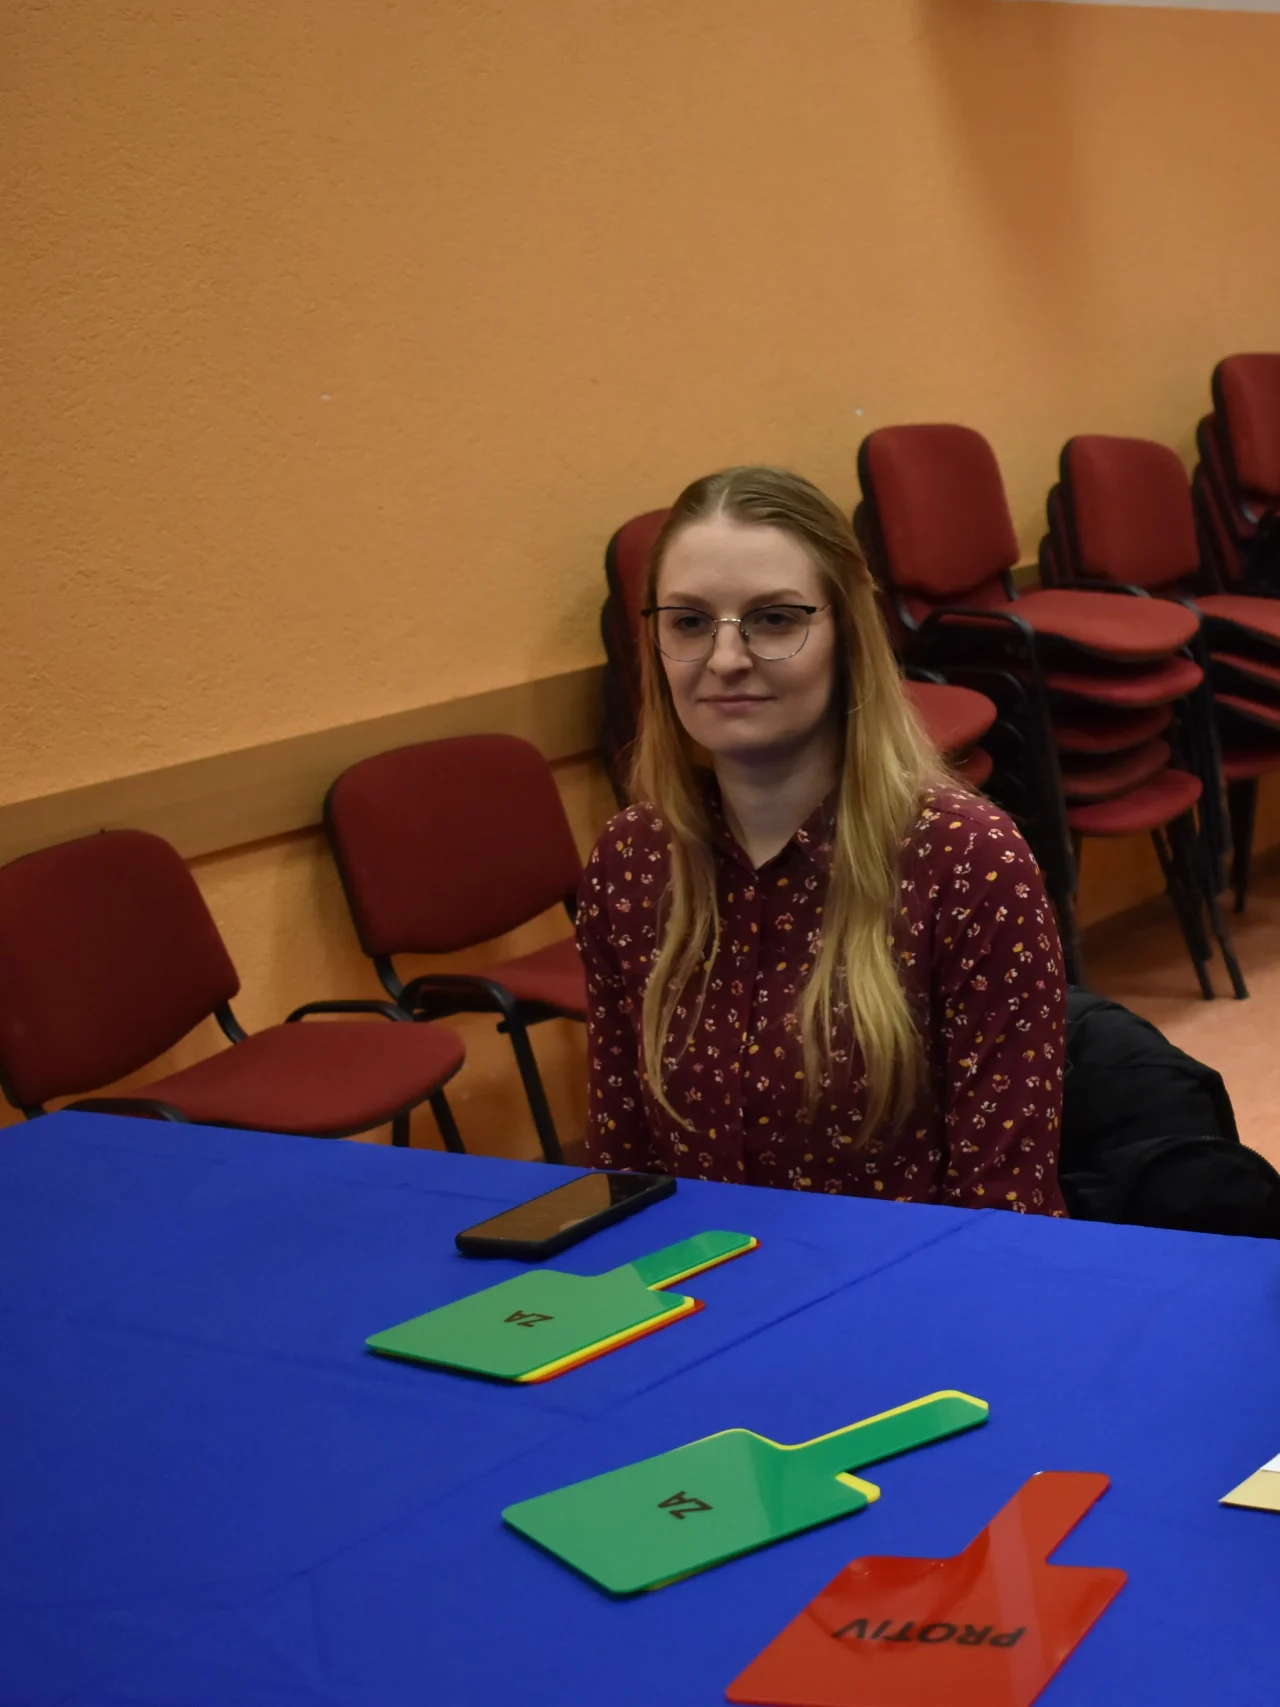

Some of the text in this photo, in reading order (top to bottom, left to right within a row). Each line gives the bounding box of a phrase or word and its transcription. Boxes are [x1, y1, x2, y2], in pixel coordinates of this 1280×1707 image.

[503, 1309, 554, 1328] ZA
[657, 1490, 713, 1520] ZA
[830, 1618, 1027, 1648] PROTIV
